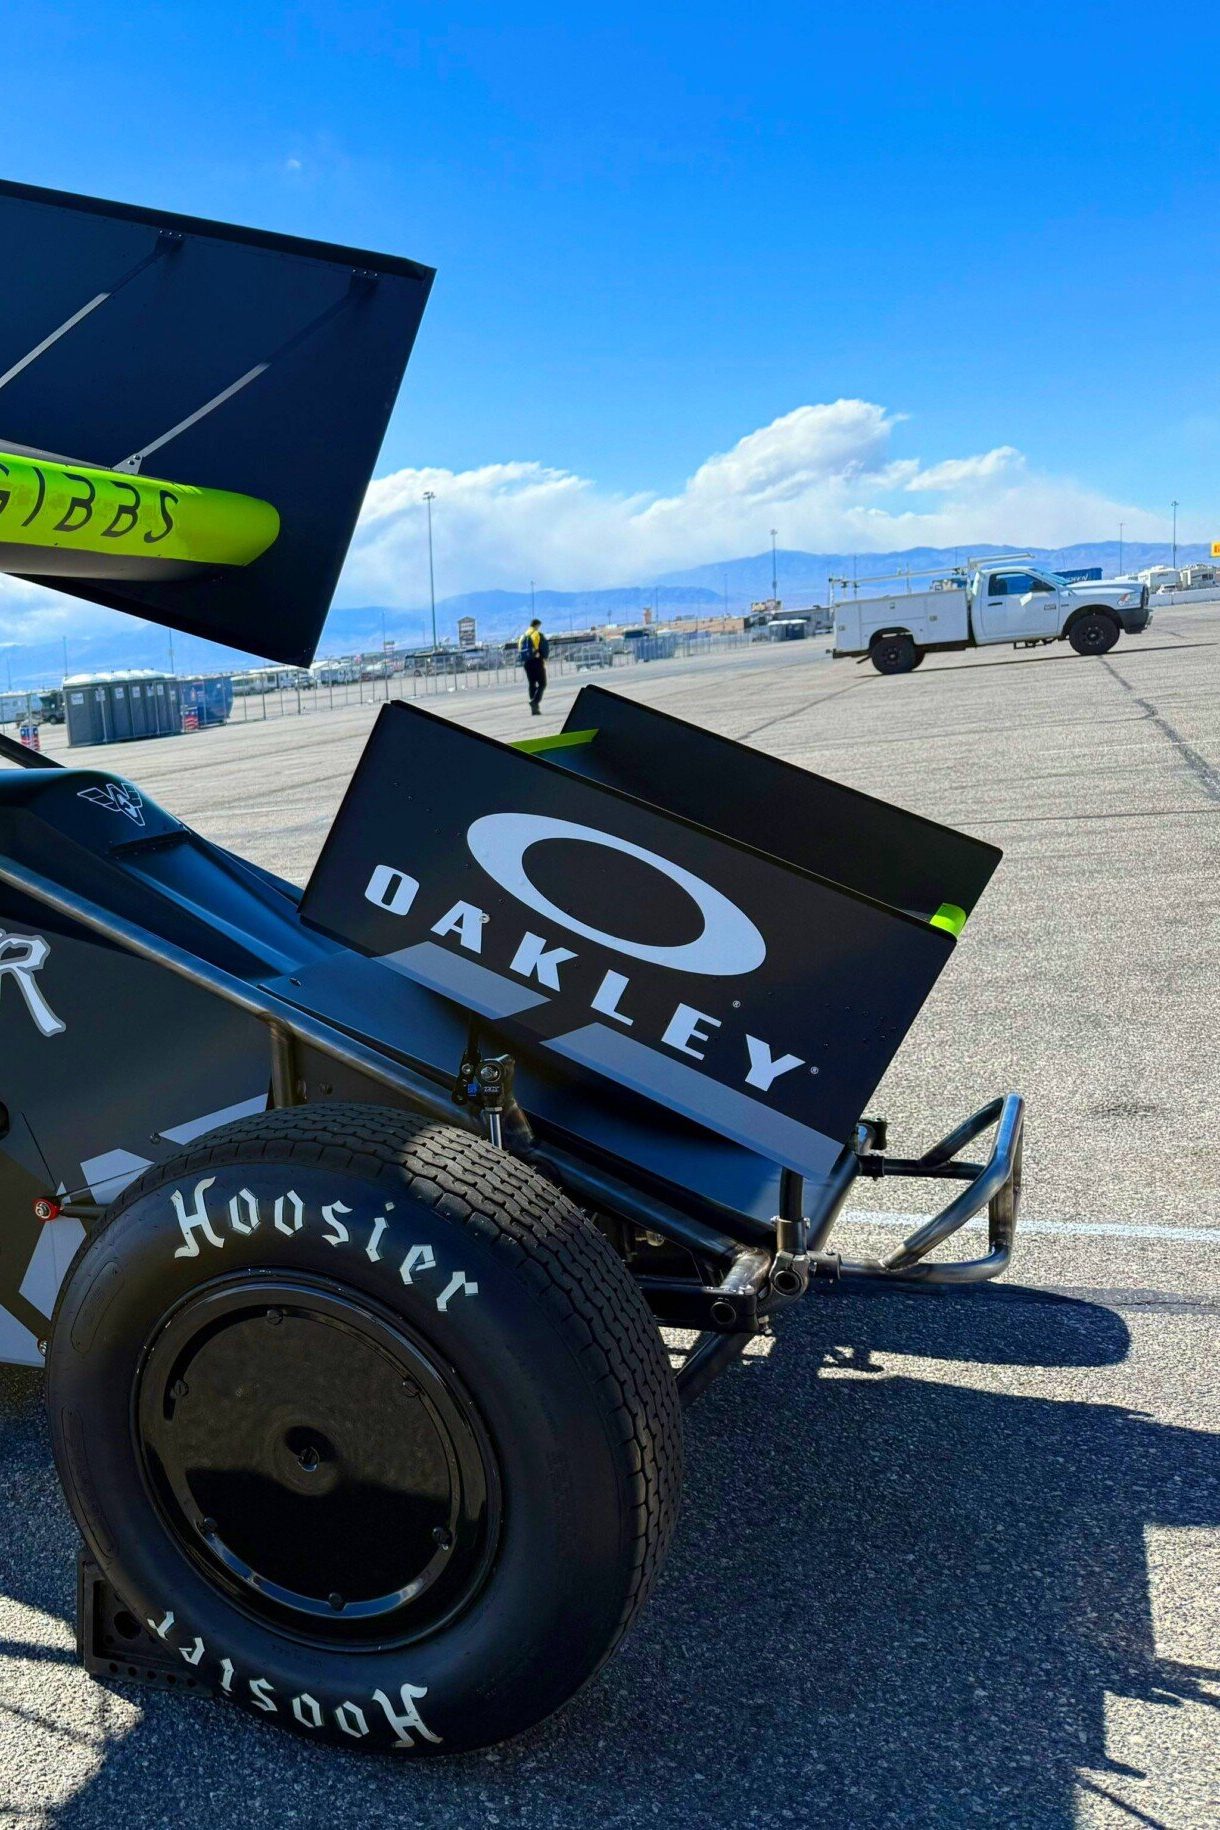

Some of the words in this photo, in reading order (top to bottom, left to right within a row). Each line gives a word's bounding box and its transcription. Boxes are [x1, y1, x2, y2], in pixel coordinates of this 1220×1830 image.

[365, 864, 806, 1093] OAKLEY
[170, 1176, 479, 1312] Hoosier
[146, 1610, 444, 1748] Hoosier
